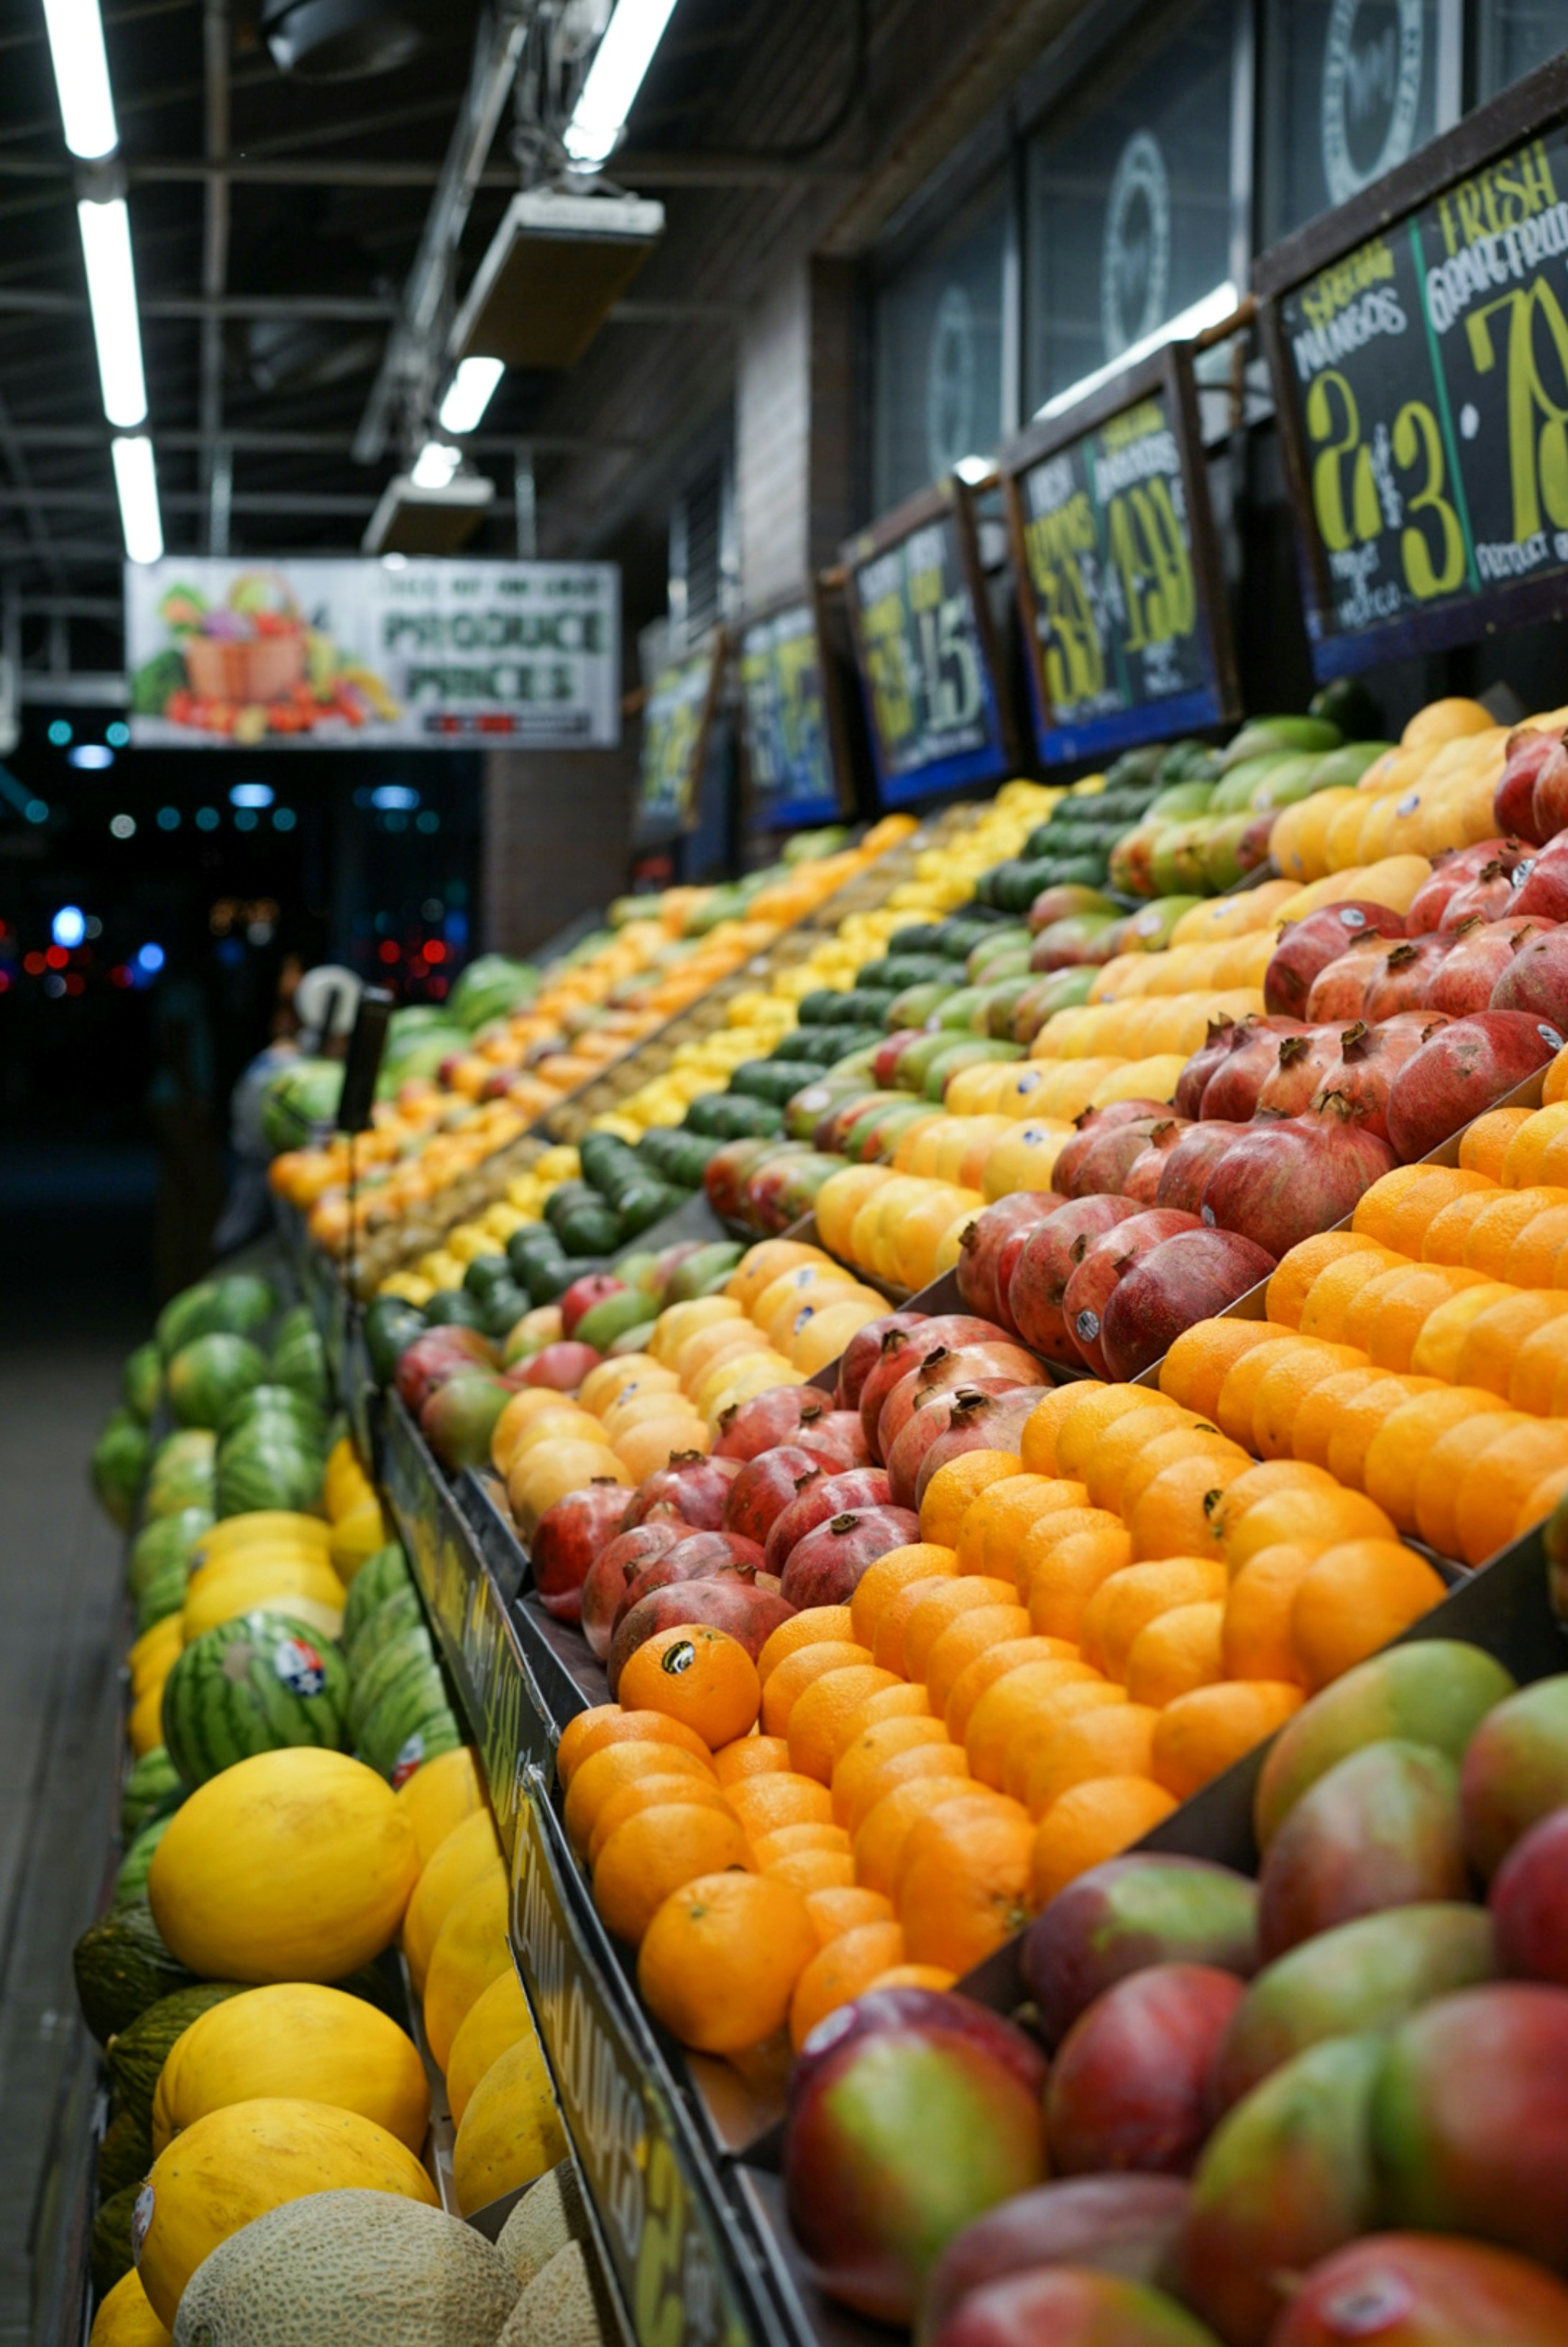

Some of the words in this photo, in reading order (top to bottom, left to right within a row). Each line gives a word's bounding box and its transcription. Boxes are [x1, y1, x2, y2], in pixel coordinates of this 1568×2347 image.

[1441, 139, 1559, 256] FRESH
[1294, 288, 1407, 381] MANGOS
[1307, 370, 1383, 552] 2
[1393, 401, 1468, 599] 3
[383, 608, 602, 654] PRODUCE
[407, 663, 571, 701] PRICES
